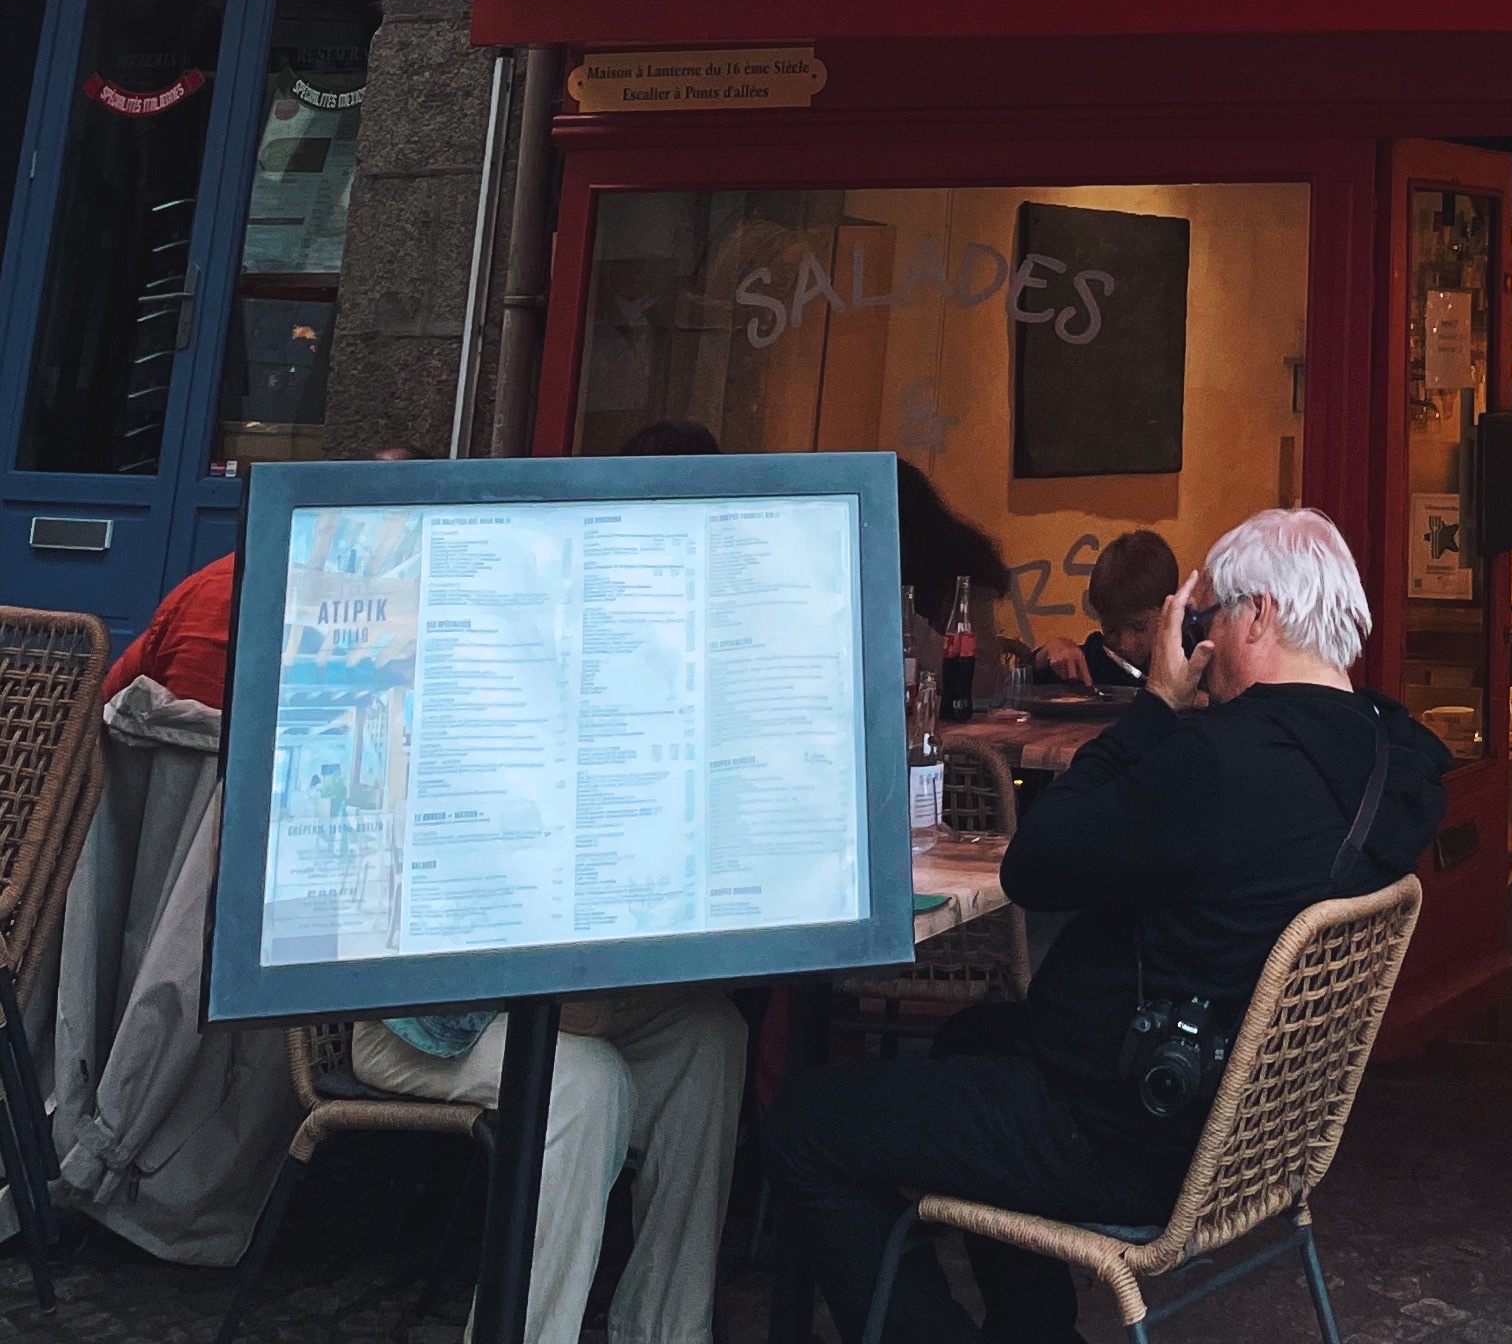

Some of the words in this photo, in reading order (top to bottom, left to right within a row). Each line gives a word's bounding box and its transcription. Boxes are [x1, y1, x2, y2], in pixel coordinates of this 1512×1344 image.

[587, 66, 632, 79] Maison
[647, 64, 701, 77] Lanterne
[705, 62, 721, 75] du
[726, 61, 740, 75] 16
[623, 87, 671, 101] Escalier
[735, 233, 1116, 349] SALADES
[317, 598, 388, 625] ATIPIK
